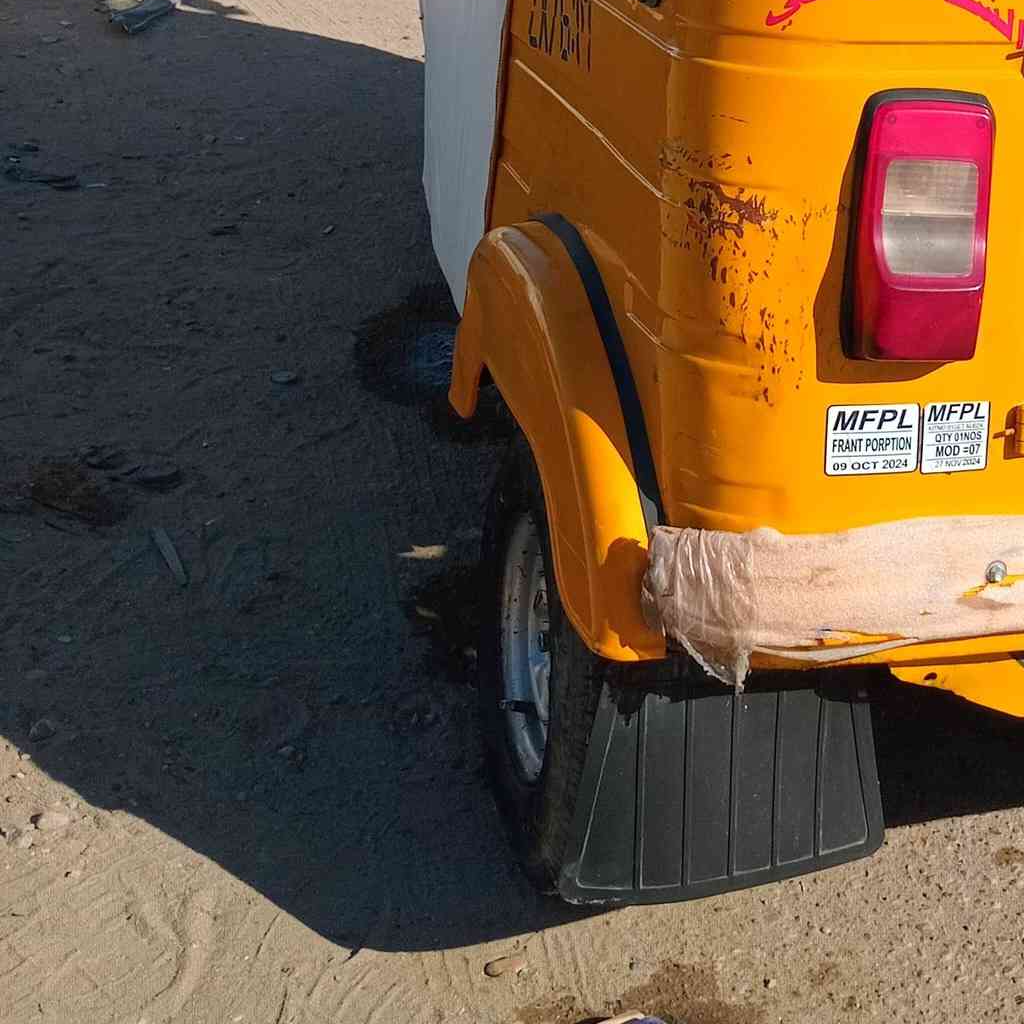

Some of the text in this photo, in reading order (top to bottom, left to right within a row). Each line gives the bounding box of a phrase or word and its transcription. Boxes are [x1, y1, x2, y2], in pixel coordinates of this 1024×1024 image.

[927, 402, 986, 422] MFPL
[832, 408, 913, 431] MFPL
[935, 431, 982, 443] QTY 01NOS
[831, 436, 912, 453] FRANT PORPTION
[935, 445, 960, 457] MOD
[832, 459, 908, 471] 09 OCT 2024
